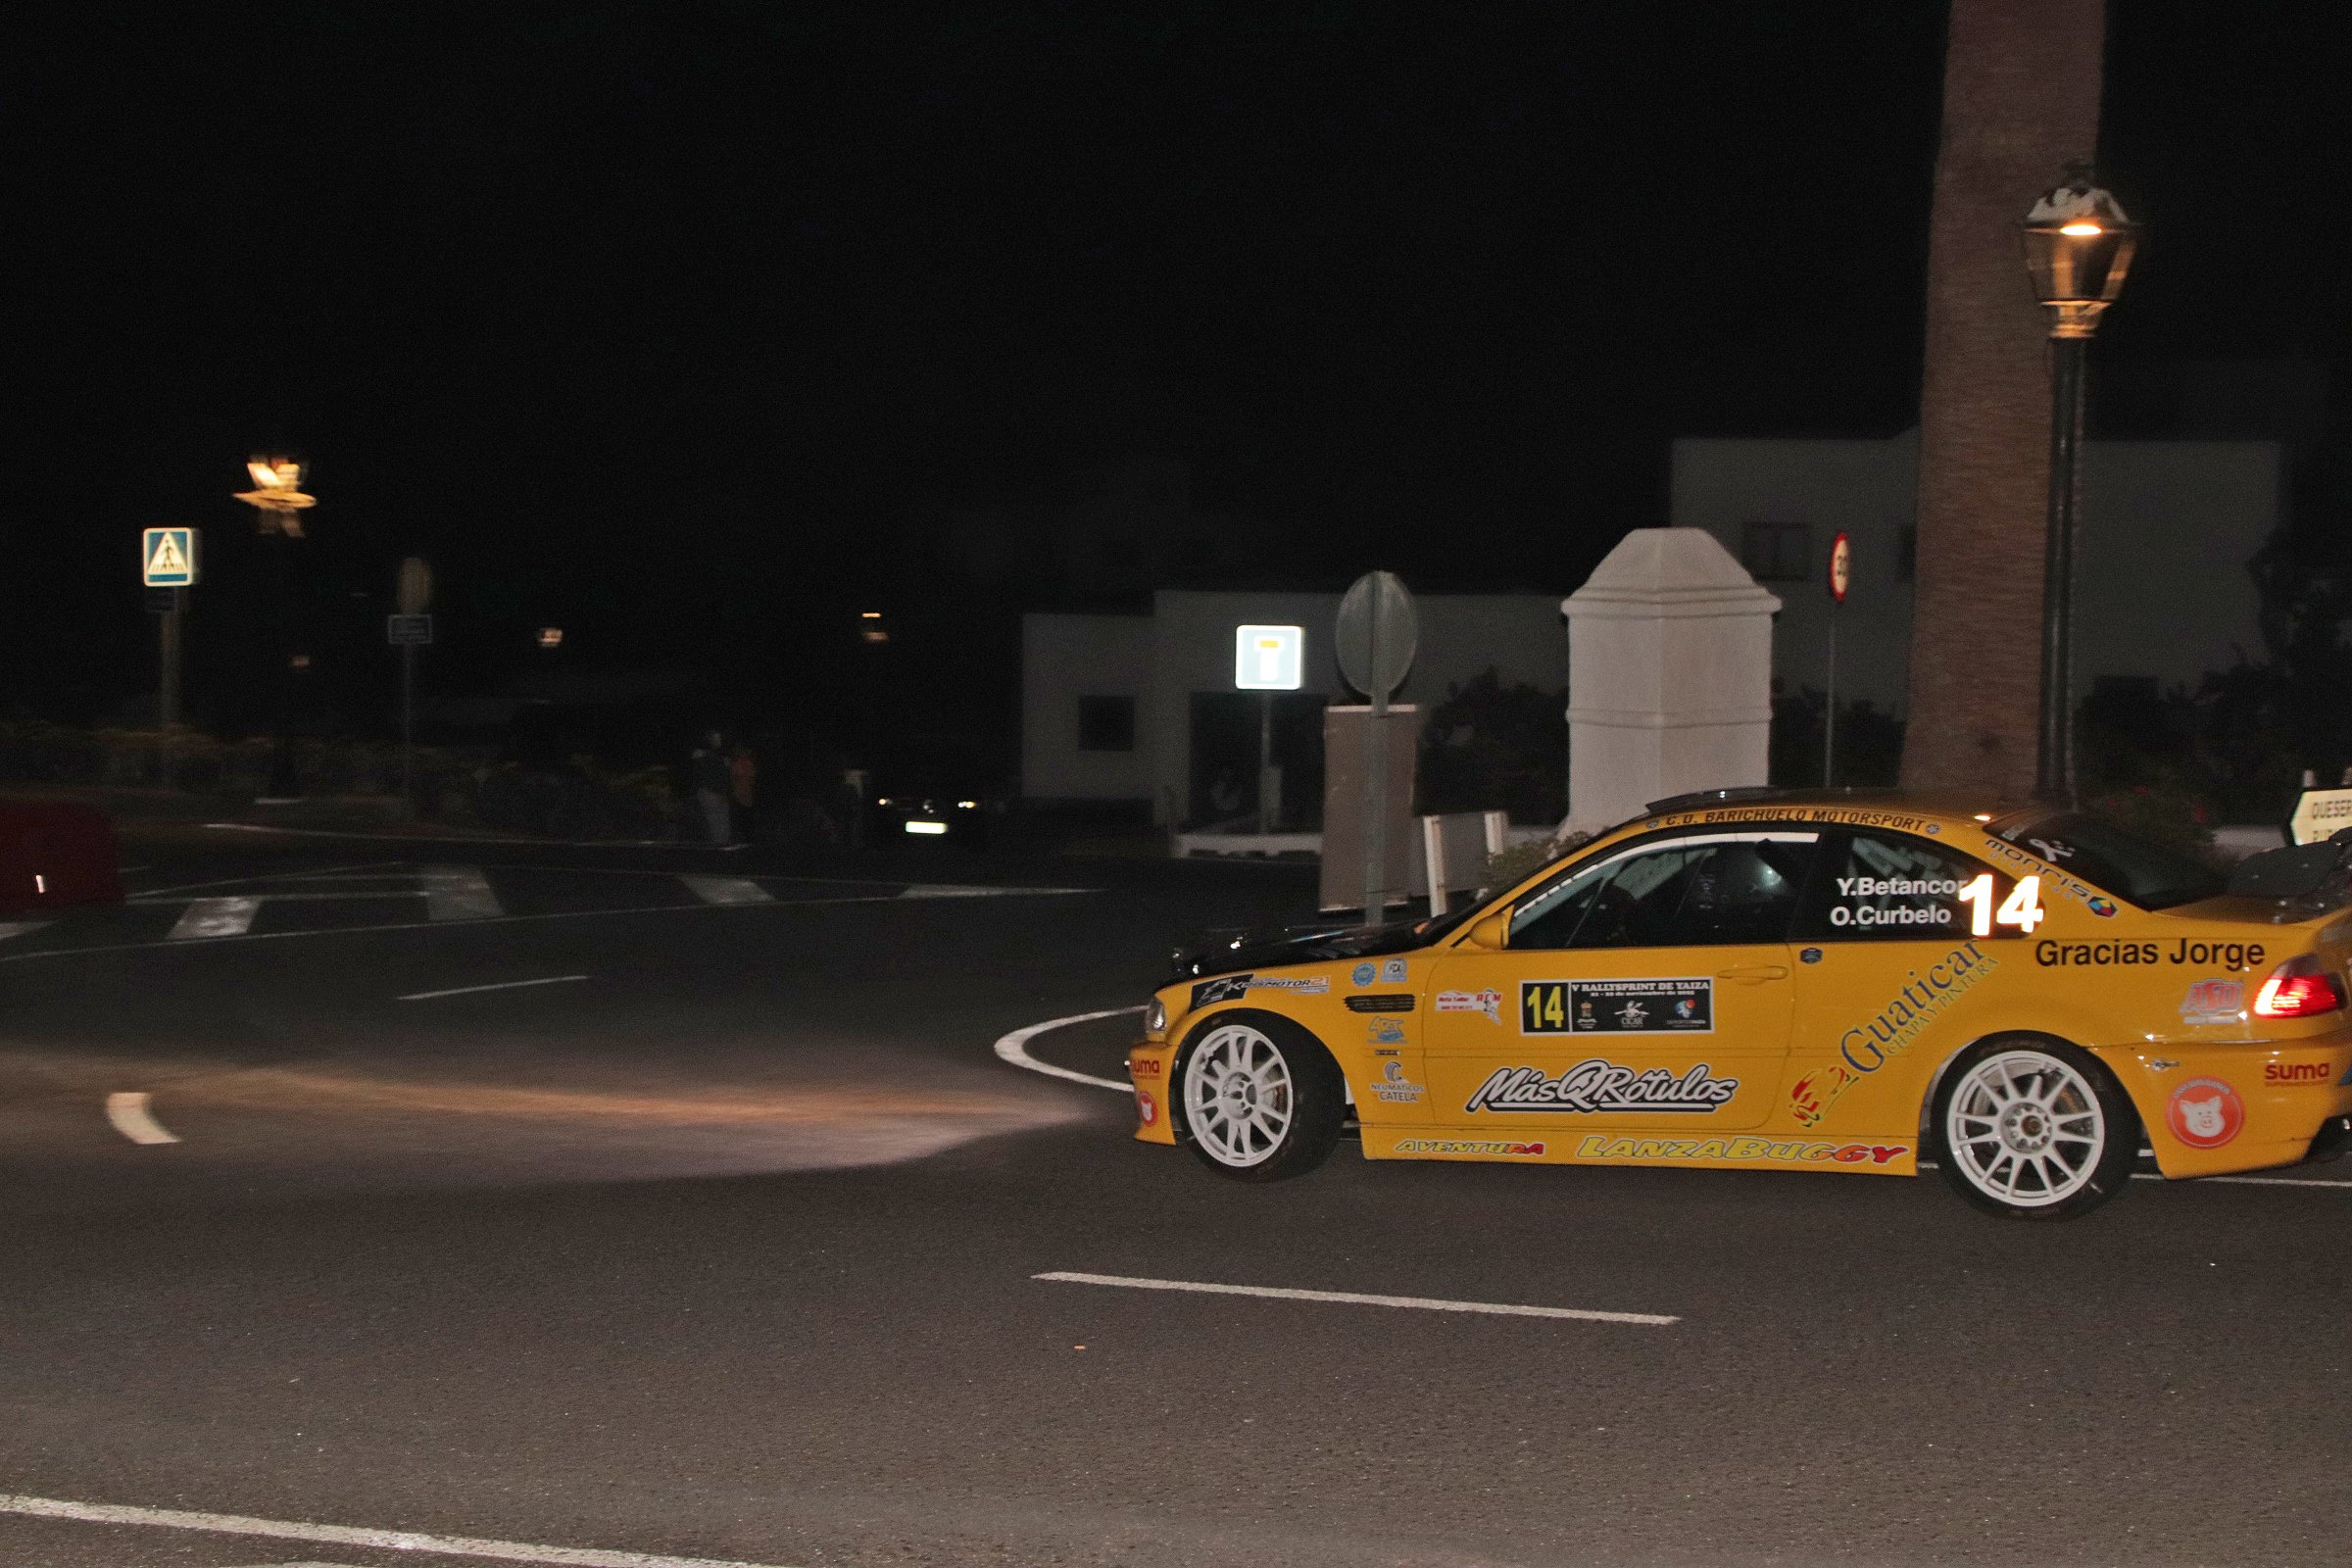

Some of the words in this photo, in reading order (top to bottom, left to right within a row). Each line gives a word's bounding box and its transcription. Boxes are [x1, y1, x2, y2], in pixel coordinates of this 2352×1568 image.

[1811, 809, 1927, 831] MOTORSPORT
[1830, 904, 1952, 926] O.Curbelo
[1958, 873, 2044, 937] 14
[2034, 938, 2160, 967] Gracias
[2169, 938, 2266, 972] Jorge
[1571, 983, 1580, 992] V
[1581, 982, 1655, 992] RALLYSPRINT
[1656, 982, 1675, 991] DE
[1675, 981, 1710, 991] YAIZA
[1527, 985, 1565, 1029] 14
[1840, 937, 1985, 1073] Guaticar
[1379, 1091, 1418, 1102] CATELA
[1396, 1140, 1544, 1155] AVENTURA
